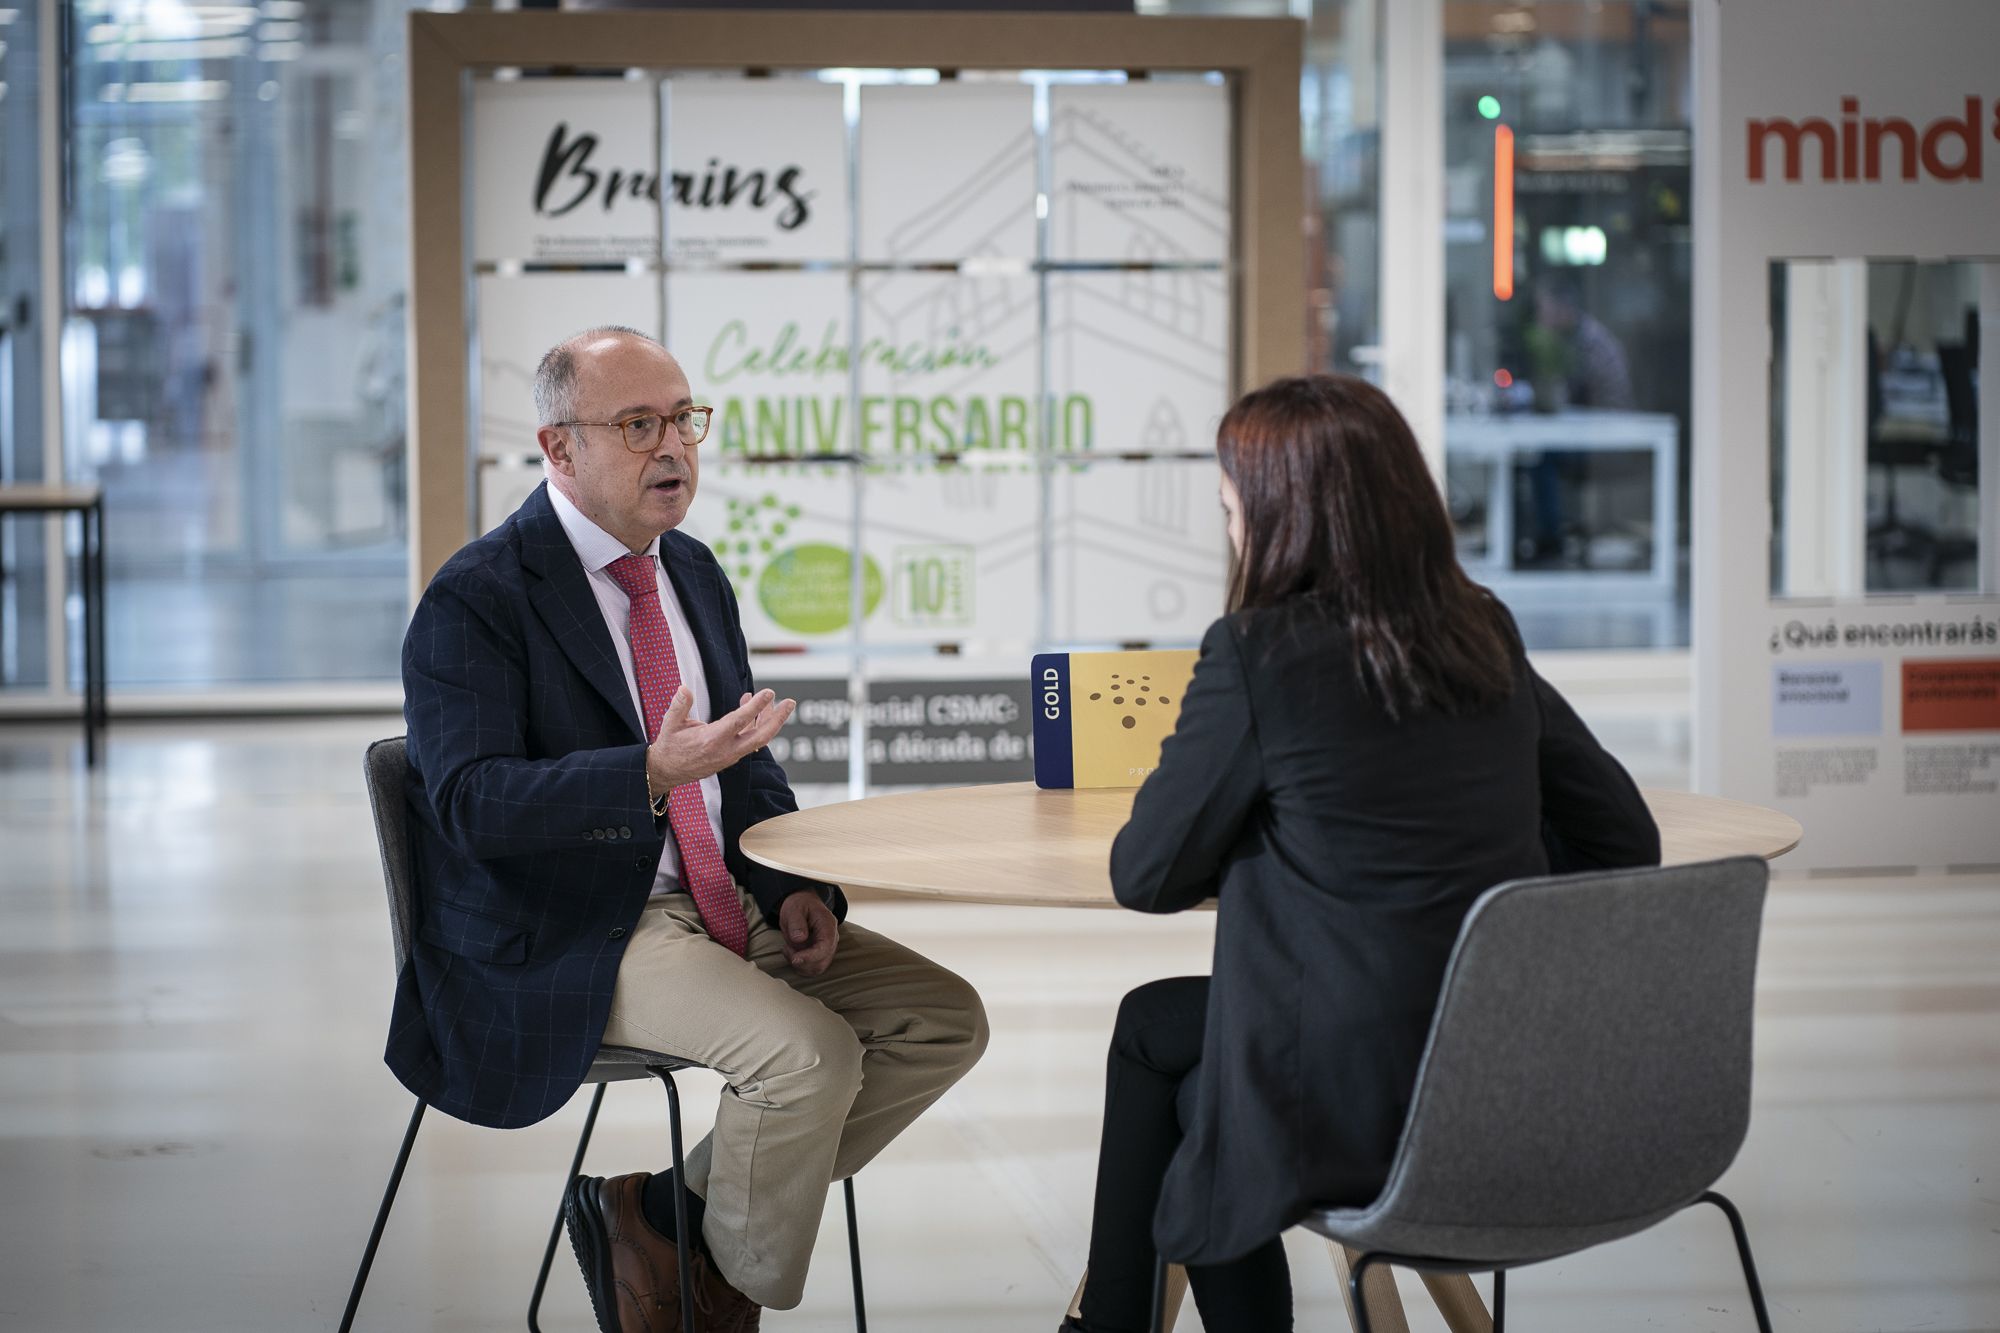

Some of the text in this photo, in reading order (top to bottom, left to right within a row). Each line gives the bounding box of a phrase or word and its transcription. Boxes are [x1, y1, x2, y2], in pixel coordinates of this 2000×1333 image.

[532, 121, 815, 231] Brains
[705, 320, 998, 385] Celebración
[720, 393, 1094, 474] ANIVERSARIO
[1769, 615, 2000, 653] ¿Qué encontrarás
[800, 695, 924, 730] especial
[1044, 668, 1060, 720] GOLD
[792, 737, 812, 761] a
[889, 729, 986, 763] década
[989, 730, 1025, 761] de
